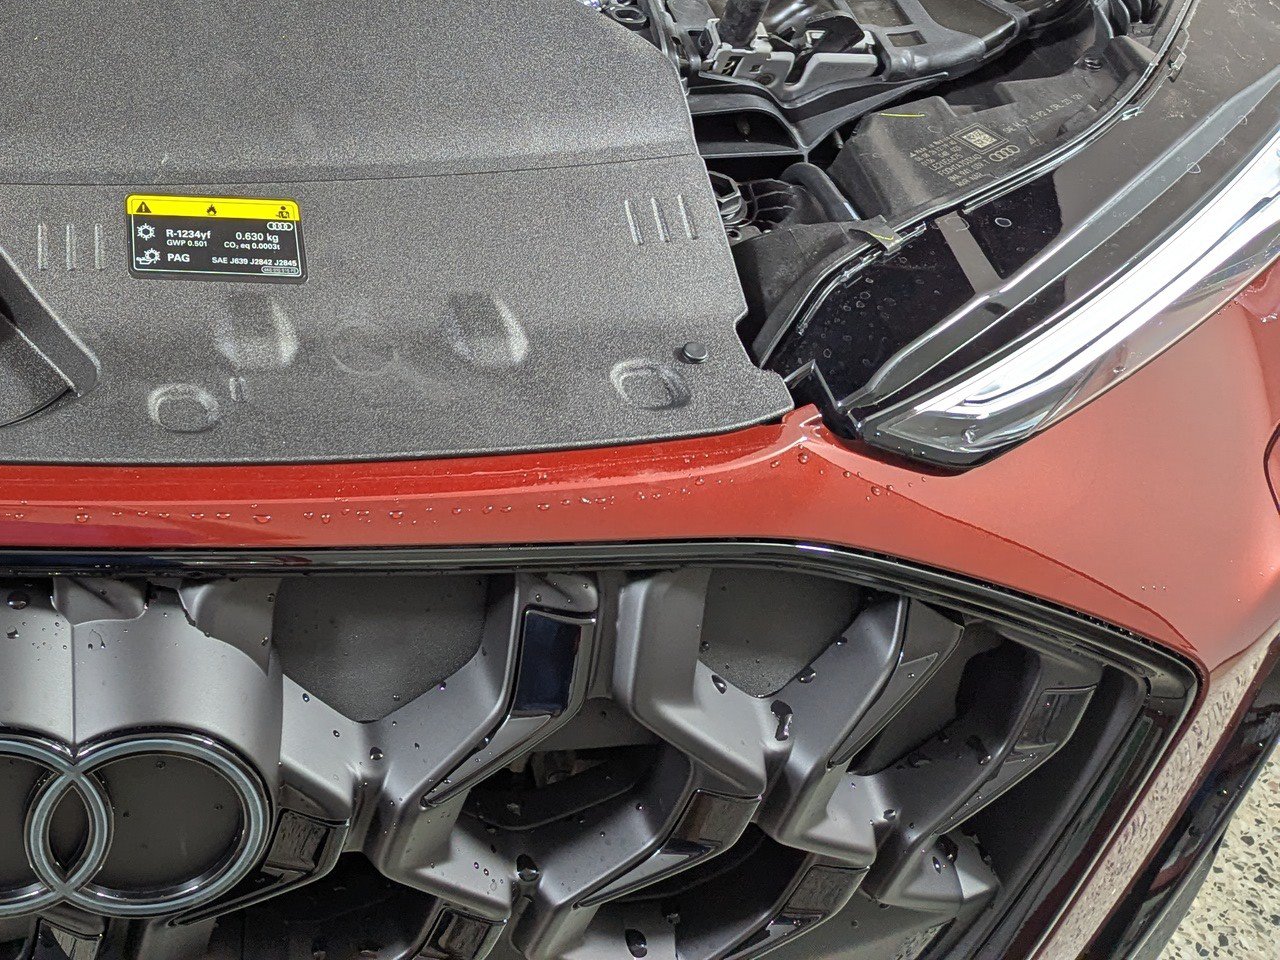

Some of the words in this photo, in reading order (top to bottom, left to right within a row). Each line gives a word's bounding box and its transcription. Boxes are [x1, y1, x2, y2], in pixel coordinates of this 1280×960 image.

[166, 229, 211, 240] R-1234yf
[235, 231, 264, 241] 0.630
[266, 232, 279, 243] kg
[166, 239, 186, 247] GWP
[167, 253, 190, 262] PAG
[211, 256, 228, 264] SAE
[229, 257, 248, 265] J639
[249, 257, 273, 266] J2842
